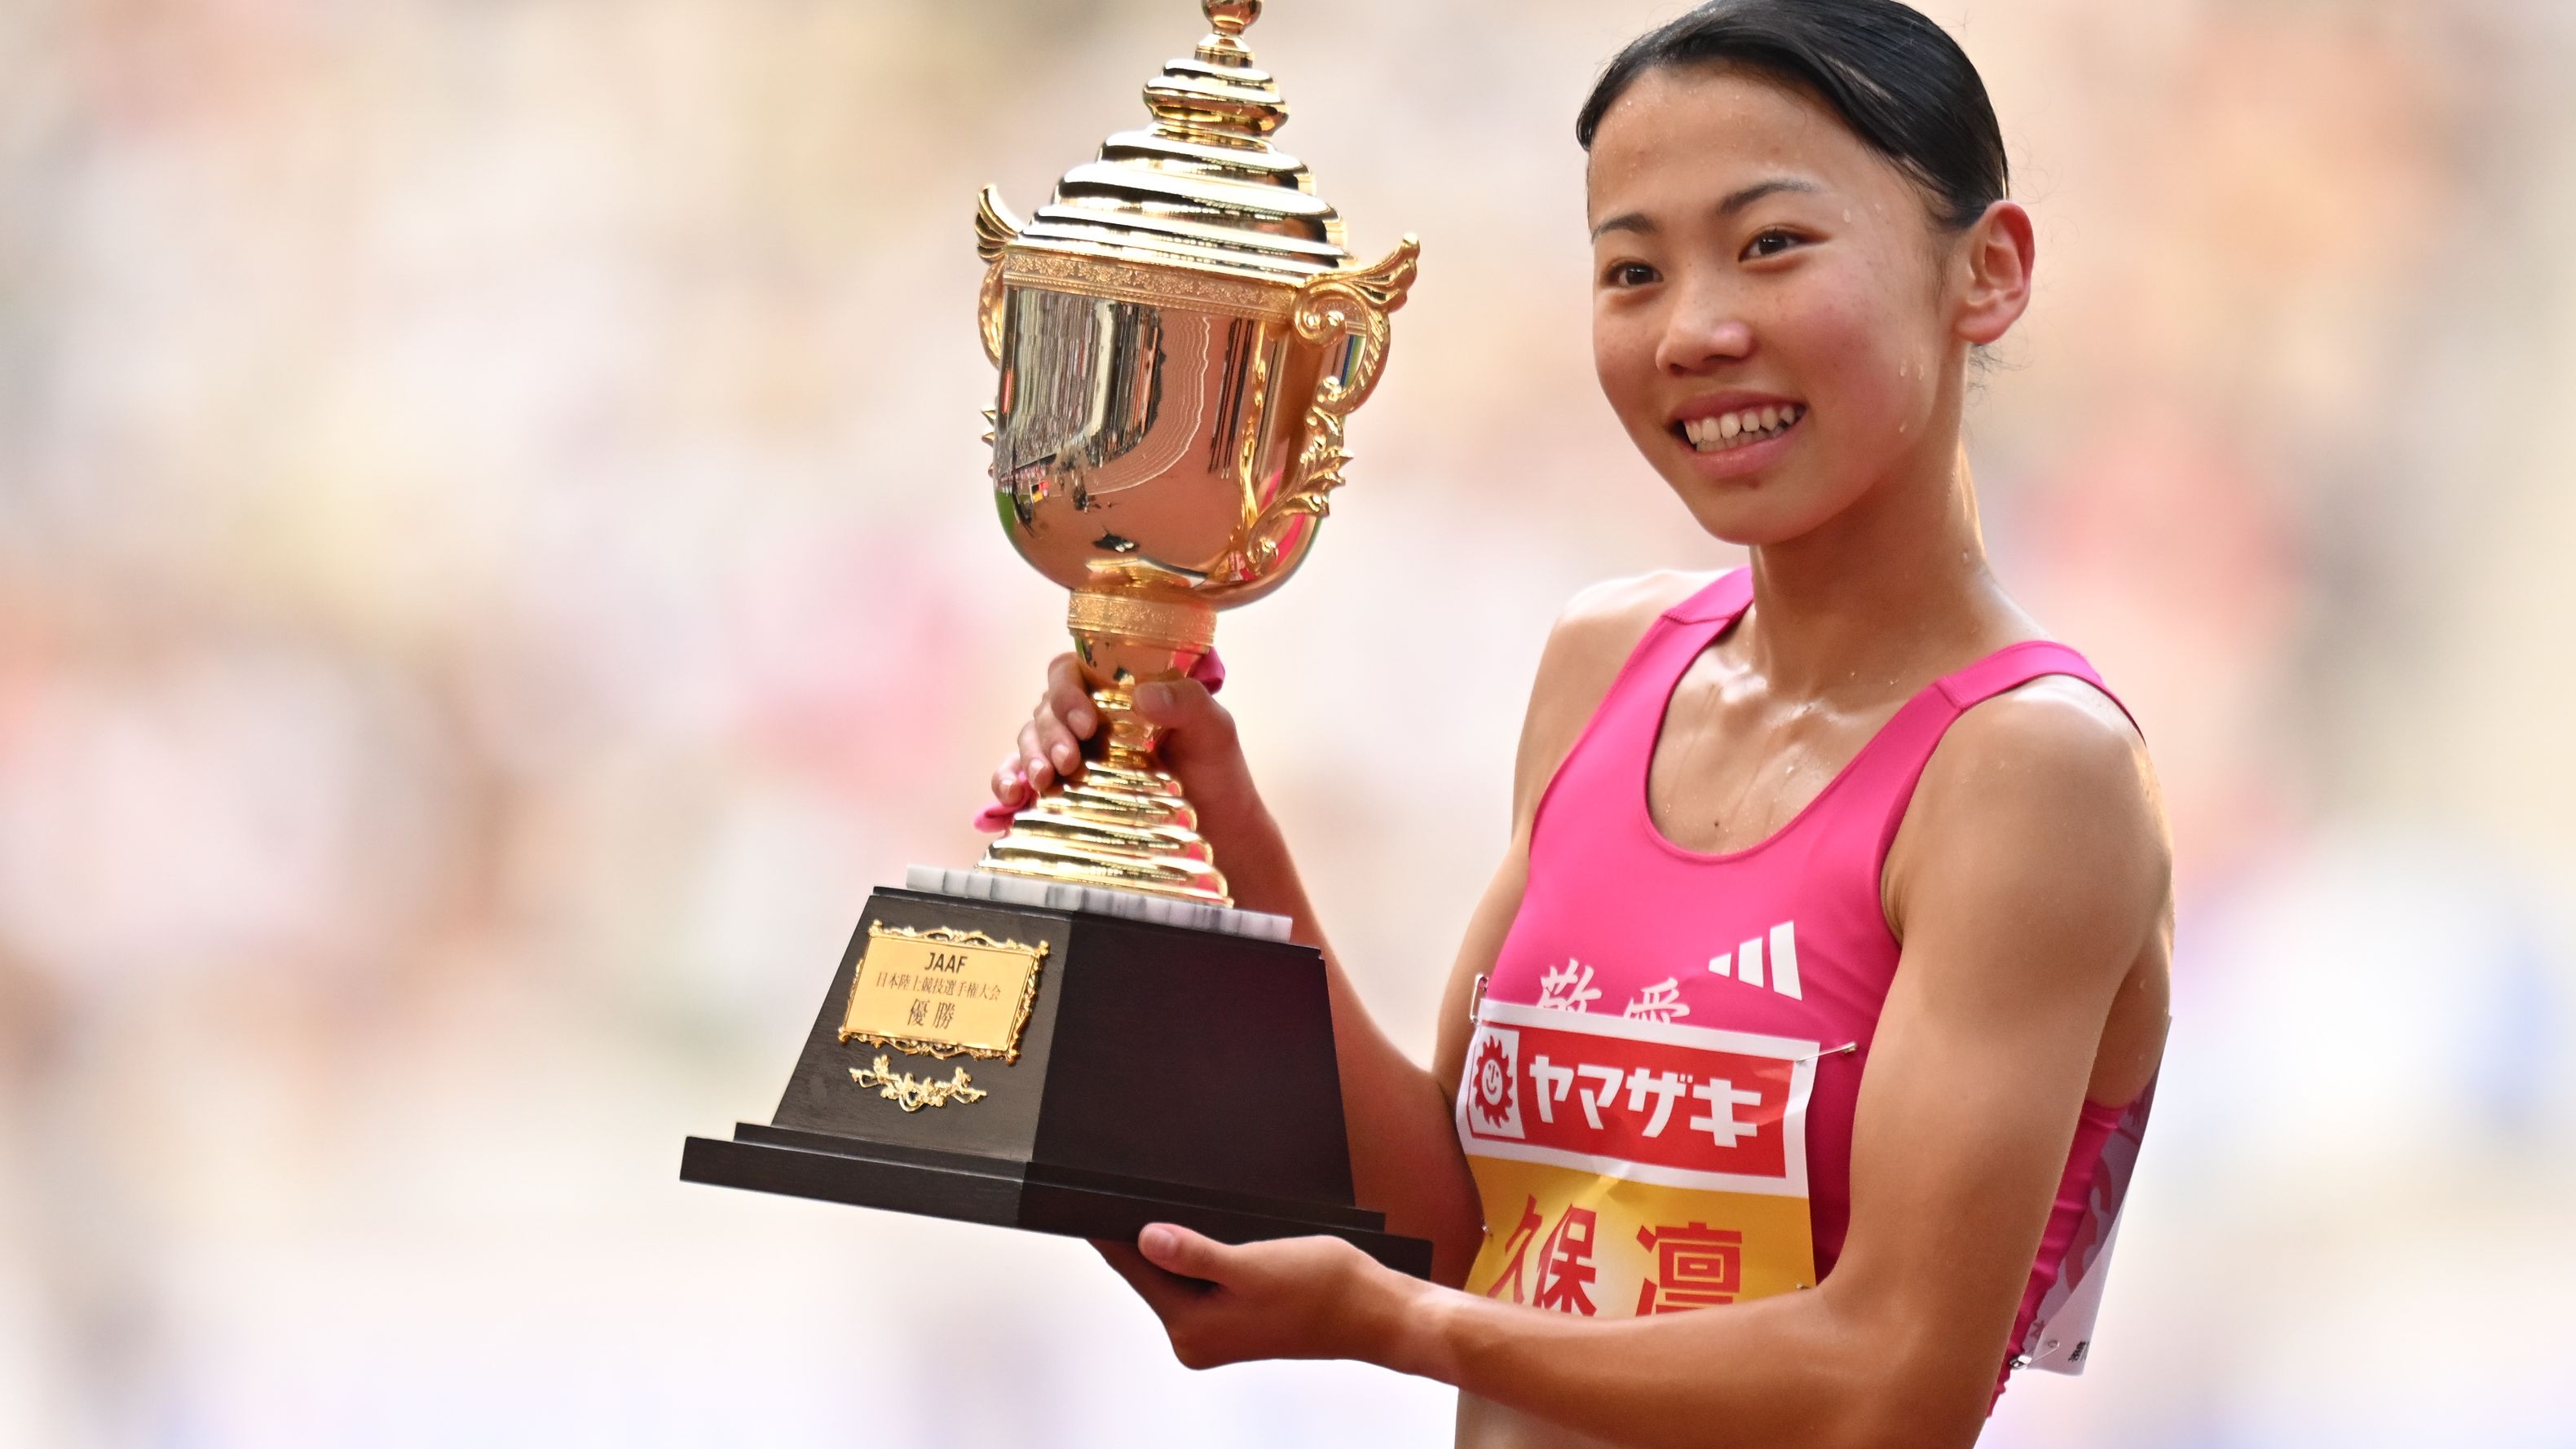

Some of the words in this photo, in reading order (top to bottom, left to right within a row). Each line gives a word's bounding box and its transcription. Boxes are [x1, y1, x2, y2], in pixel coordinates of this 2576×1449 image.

[924, 952, 968, 974] JAAF
[876, 971, 1002, 1002] 日本陸上競技選手権大会
[907, 998, 956, 1030] 優勝
[1529, 1055, 1762, 1148] ヤマザキ
